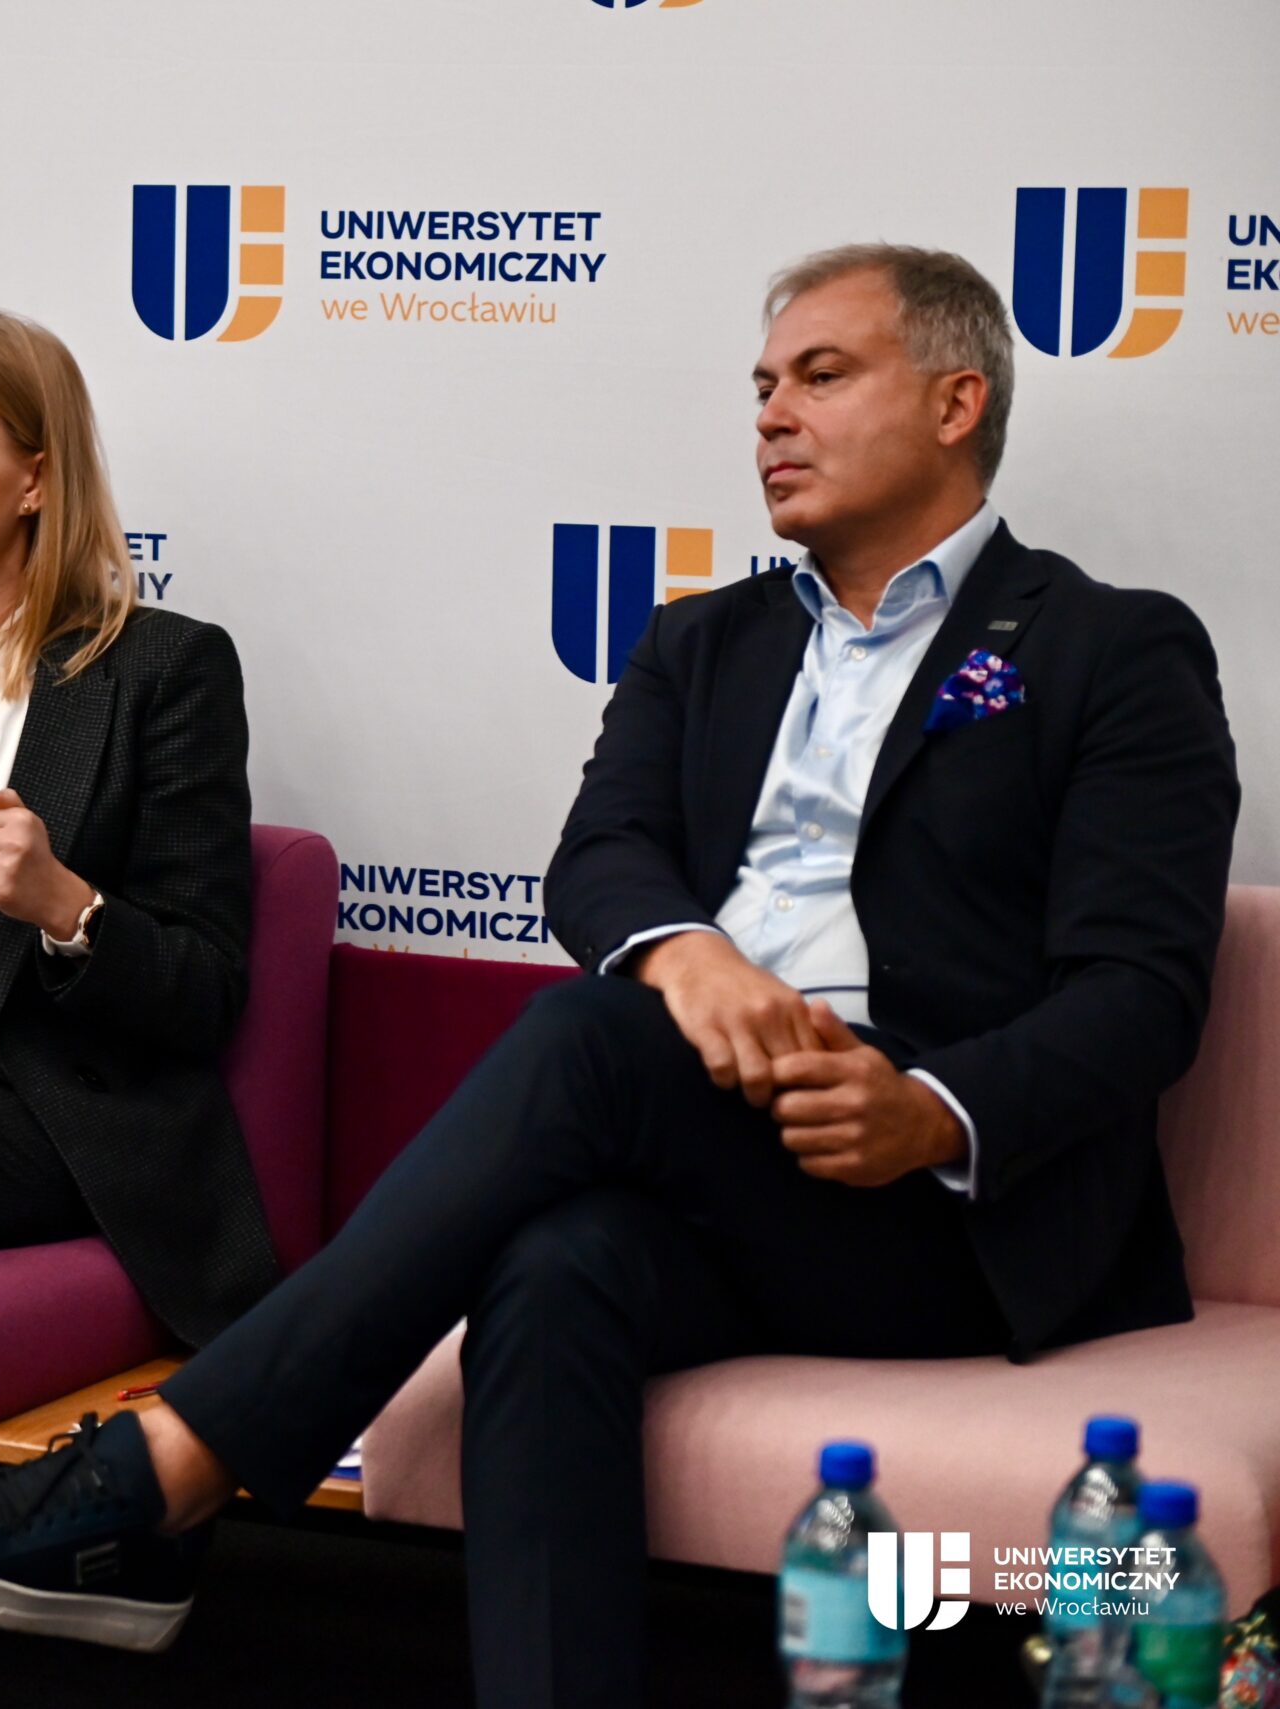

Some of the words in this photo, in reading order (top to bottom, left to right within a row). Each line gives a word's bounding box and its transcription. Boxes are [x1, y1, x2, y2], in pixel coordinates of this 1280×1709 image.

[320, 210, 602, 242] UNIWERSYTET
[1228, 214, 1280, 246] UN
[320, 250, 607, 283] EKONOMICZNY
[1227, 259, 1280, 290] EK
[321, 298, 369, 321] we
[379, 291, 558, 325] Wrocławiu
[340, 862, 542, 904] NIWERSYT
[337, 901, 551, 944] KONOMICZ
